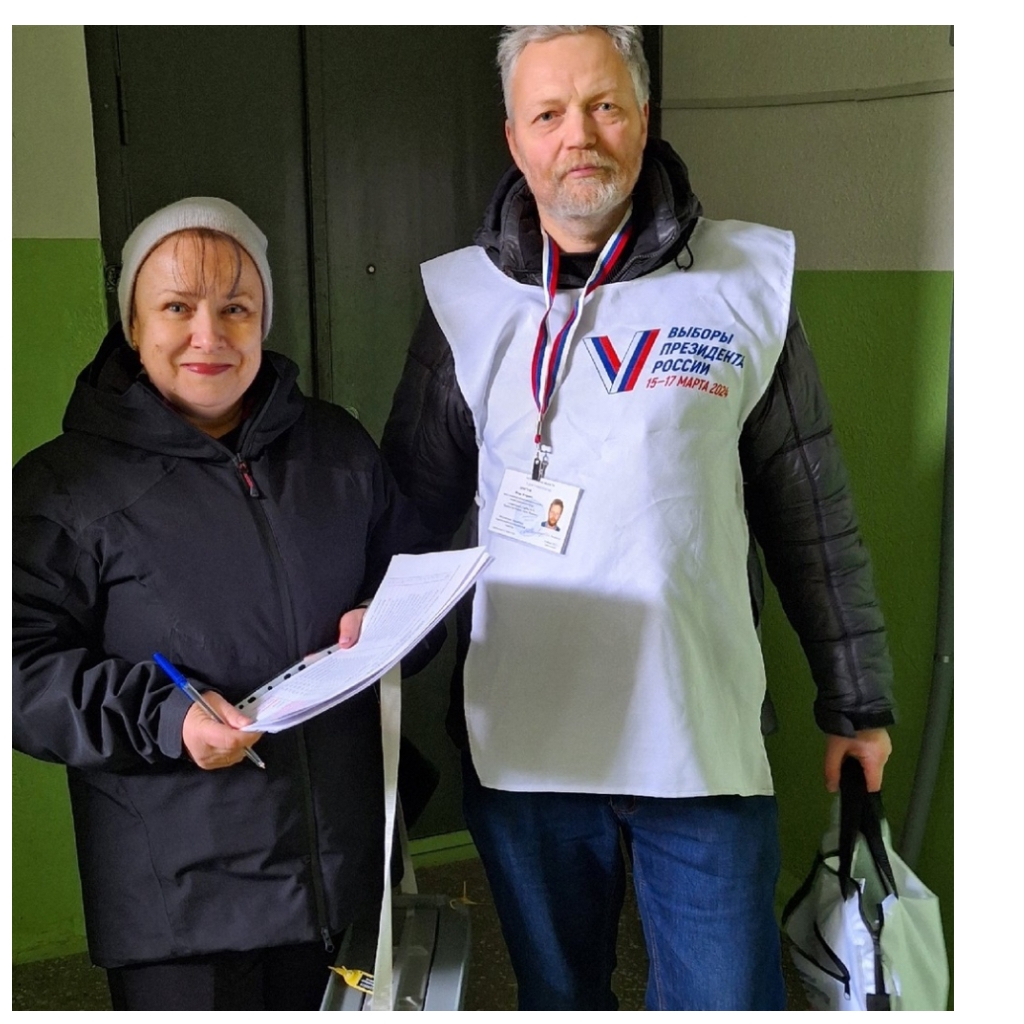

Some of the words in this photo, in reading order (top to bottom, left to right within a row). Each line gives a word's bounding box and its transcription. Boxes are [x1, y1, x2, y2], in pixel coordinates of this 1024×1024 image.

[668, 327, 735, 344] ВЫБОРЫ
[659, 343, 746, 368] ПРЕЗИДЕНТА
[652, 359, 711, 375] РОССИИ
[677, 376, 709, 391] МАРТА
[709, 383, 729, 397] 2024
